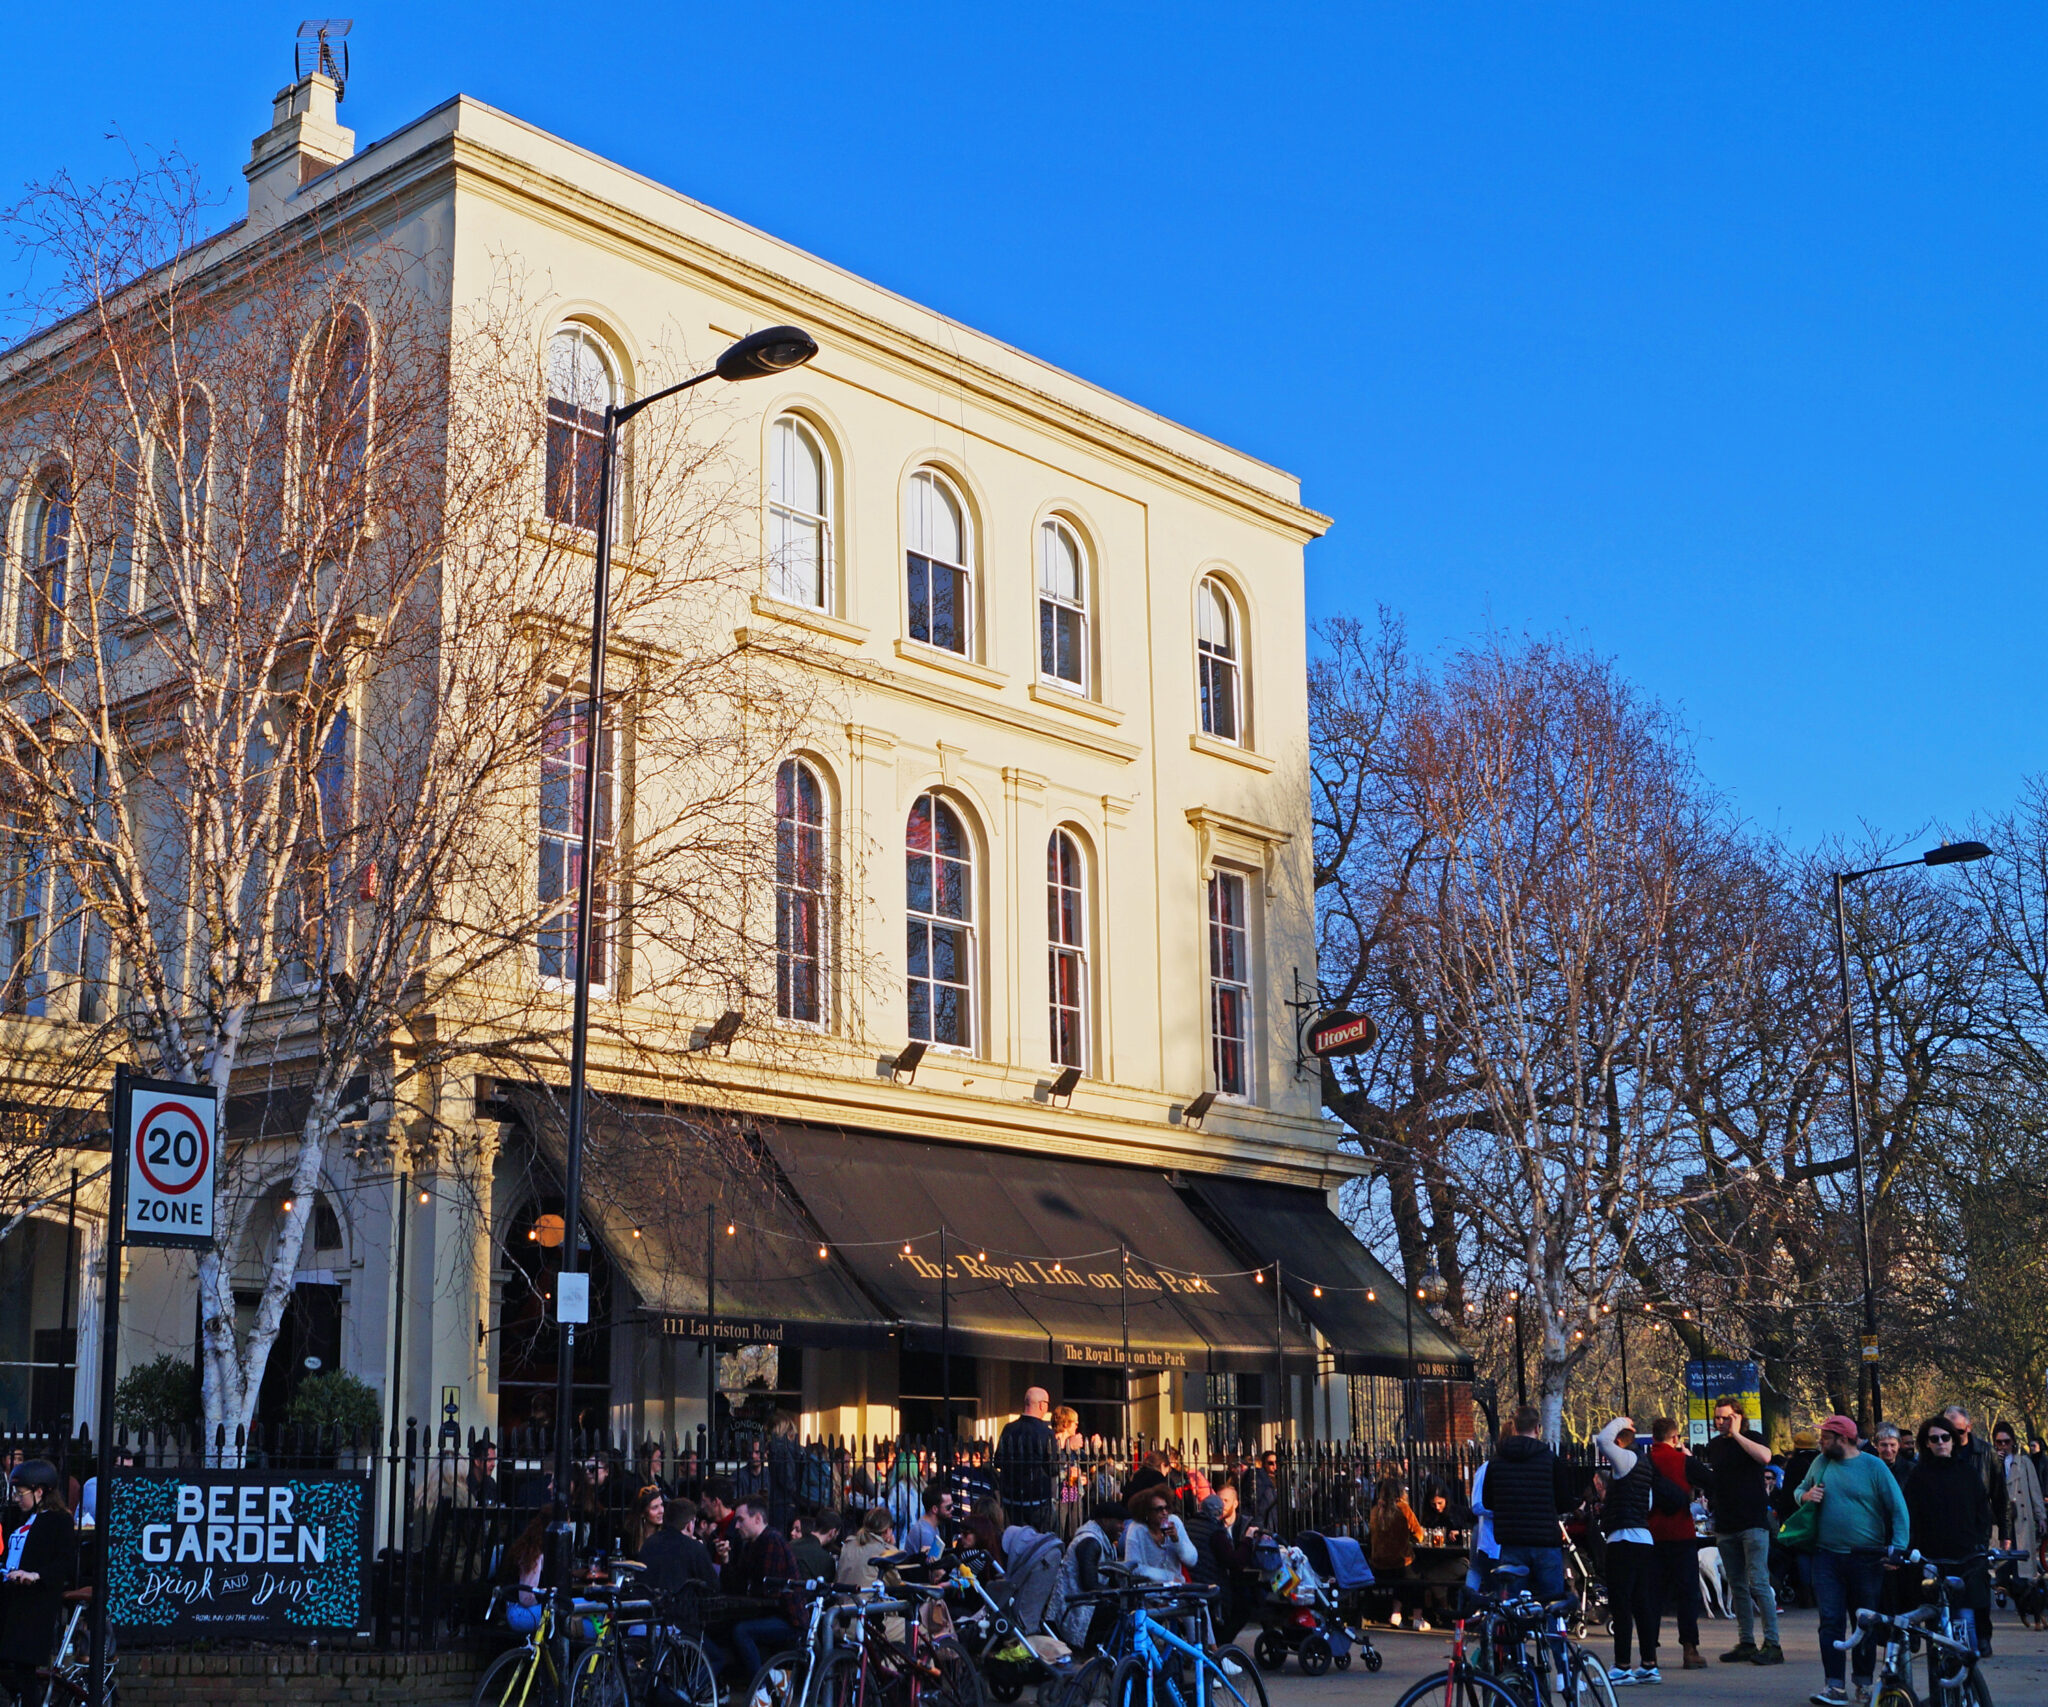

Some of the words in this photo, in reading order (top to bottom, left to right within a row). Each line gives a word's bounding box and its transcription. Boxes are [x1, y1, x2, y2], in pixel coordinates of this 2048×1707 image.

[1318, 1021, 1363, 1050] Litovel
[148, 1127, 197, 1167] 20
[137, 1199, 203, 1225] ZONE
[898, 1253, 958, 1278] The
[955, 1254, 1037, 1287] Royal
[1029, 1261, 1087, 1287] Inn
[1088, 1273, 1123, 1288] on
[1156, 1270, 1220, 1295] Park
[662, 1319, 685, 1335] 111
[753, 1323, 783, 1340] Road
[1064, 1344, 1082, 1360] The
[1085, 1346, 1112, 1365] Royal
[1134, 1352, 1146, 1364] on
[1147, 1350, 1162, 1365] the
[1164, 1352, 1186, 1366] Park
[177, 1486, 294, 1524] BEER
[142, 1524, 326, 1563] GARDEN
[138, 1567, 215, 1605] Drink
[221, 1574, 249, 1591] AND
[251, 1572, 319, 1605] Dine
